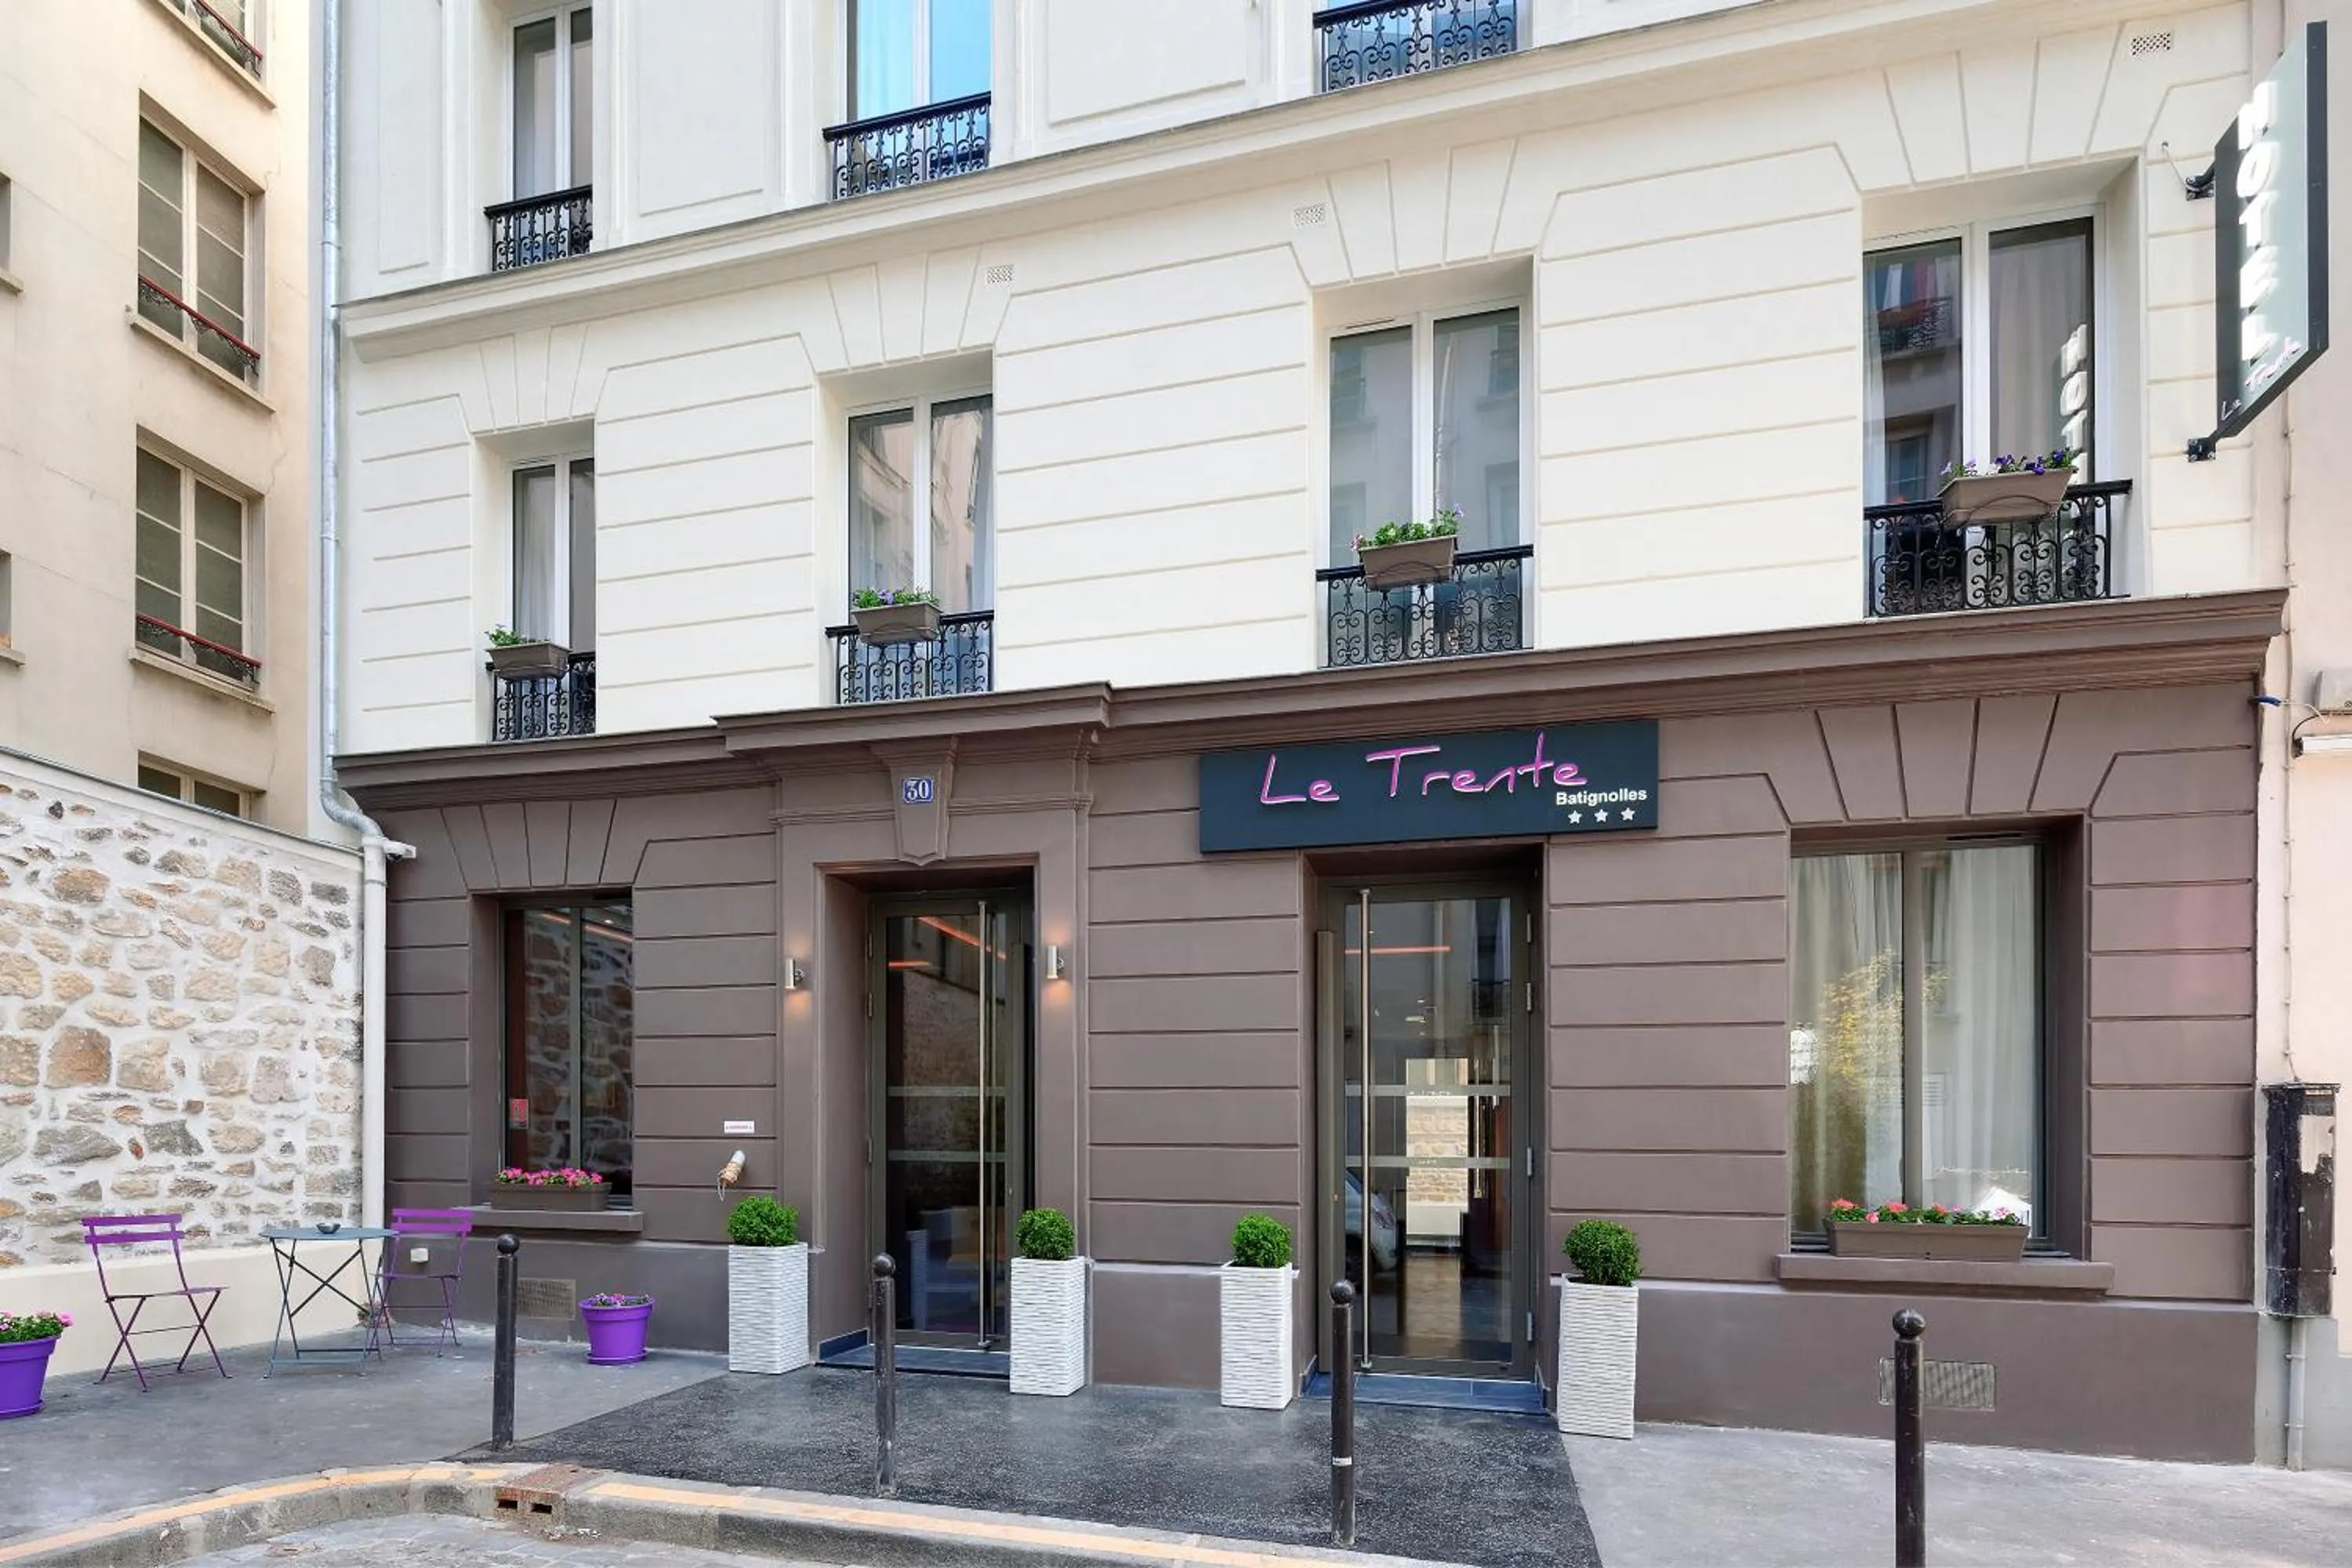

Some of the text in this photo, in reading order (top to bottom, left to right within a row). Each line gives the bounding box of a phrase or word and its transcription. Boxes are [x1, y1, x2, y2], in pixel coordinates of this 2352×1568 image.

[2236, 82, 2278, 361] HOTEL
[907, 780, 929, 800] 30
[1261, 731, 1588, 804] Le Trente
[1555, 788, 1647, 807] Batignolles
